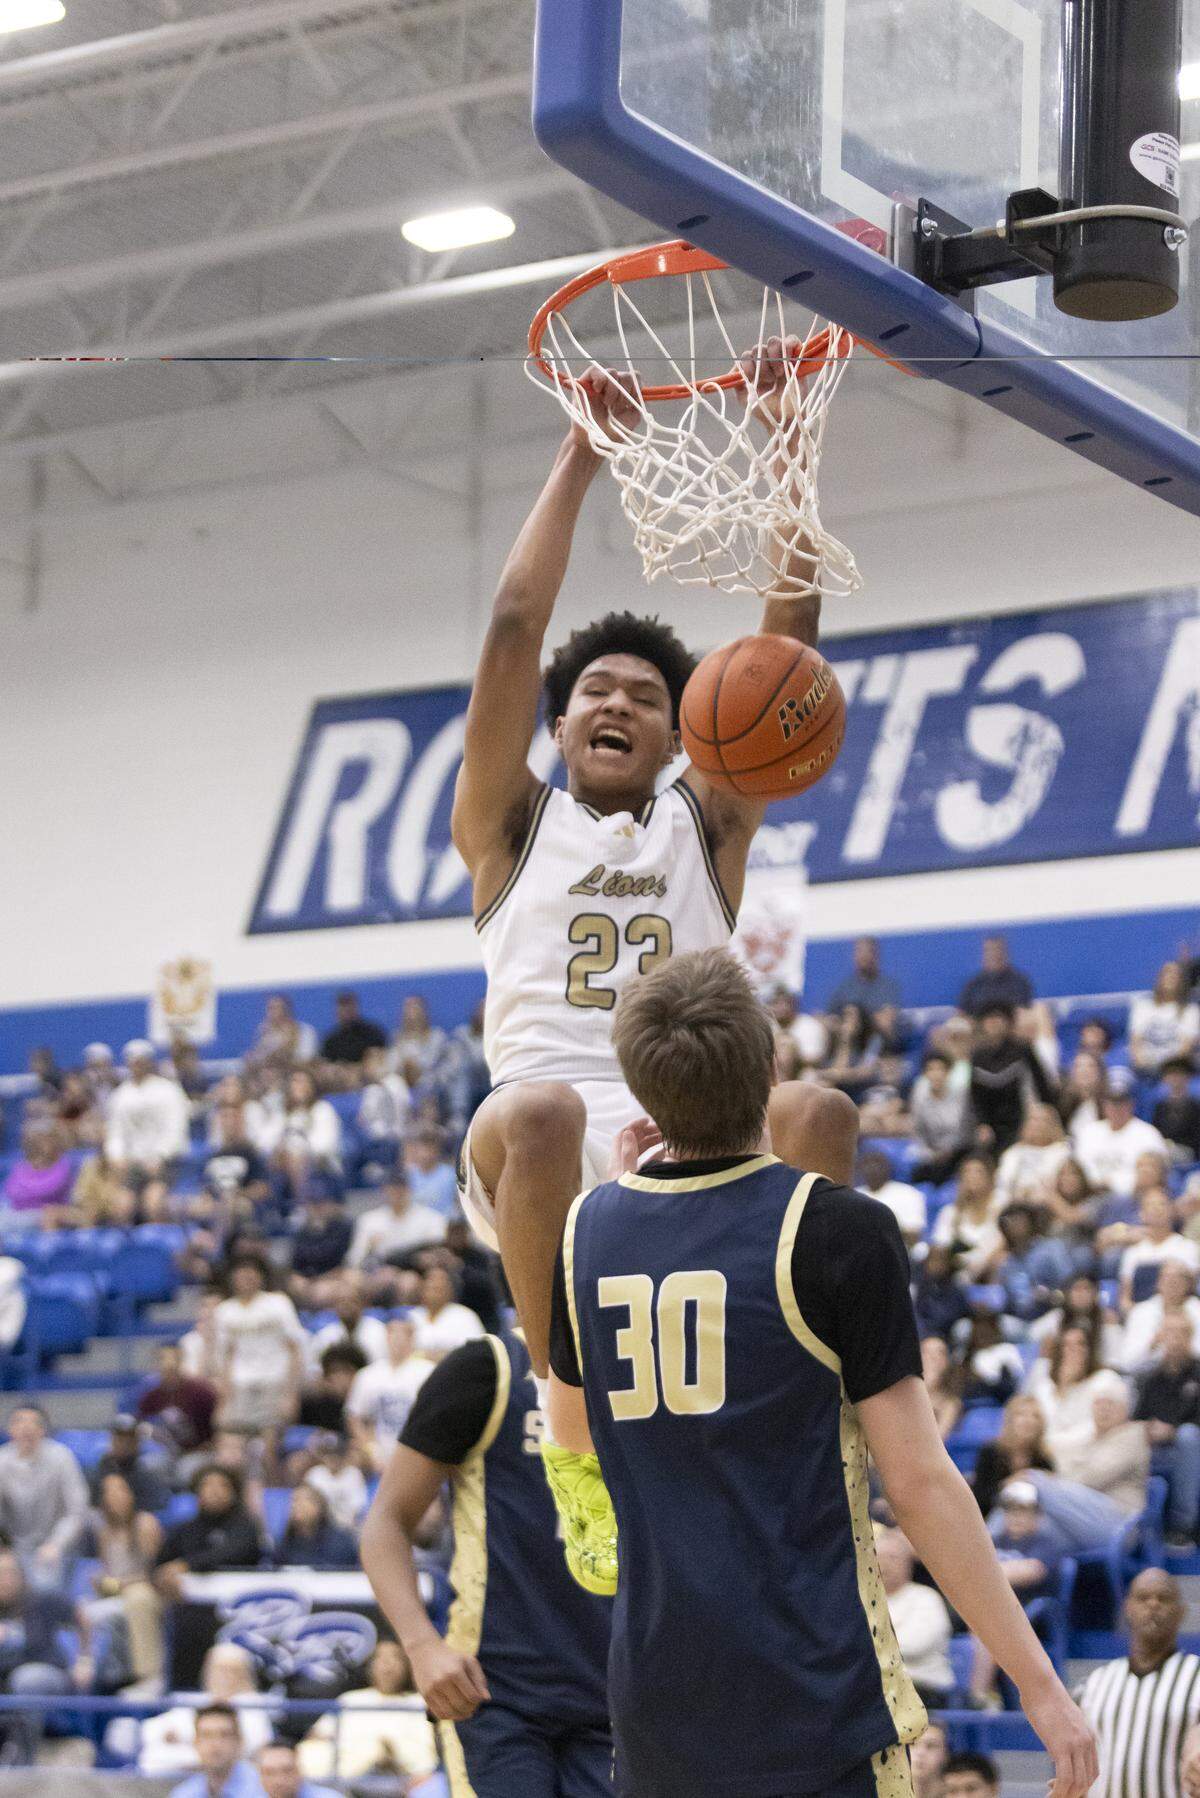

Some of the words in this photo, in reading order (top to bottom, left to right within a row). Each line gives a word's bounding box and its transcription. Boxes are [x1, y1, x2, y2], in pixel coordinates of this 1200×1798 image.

[568, 864, 668, 898] Lions
[566, 912, 673, 1011] 23
[597, 1269, 728, 1421] 30
